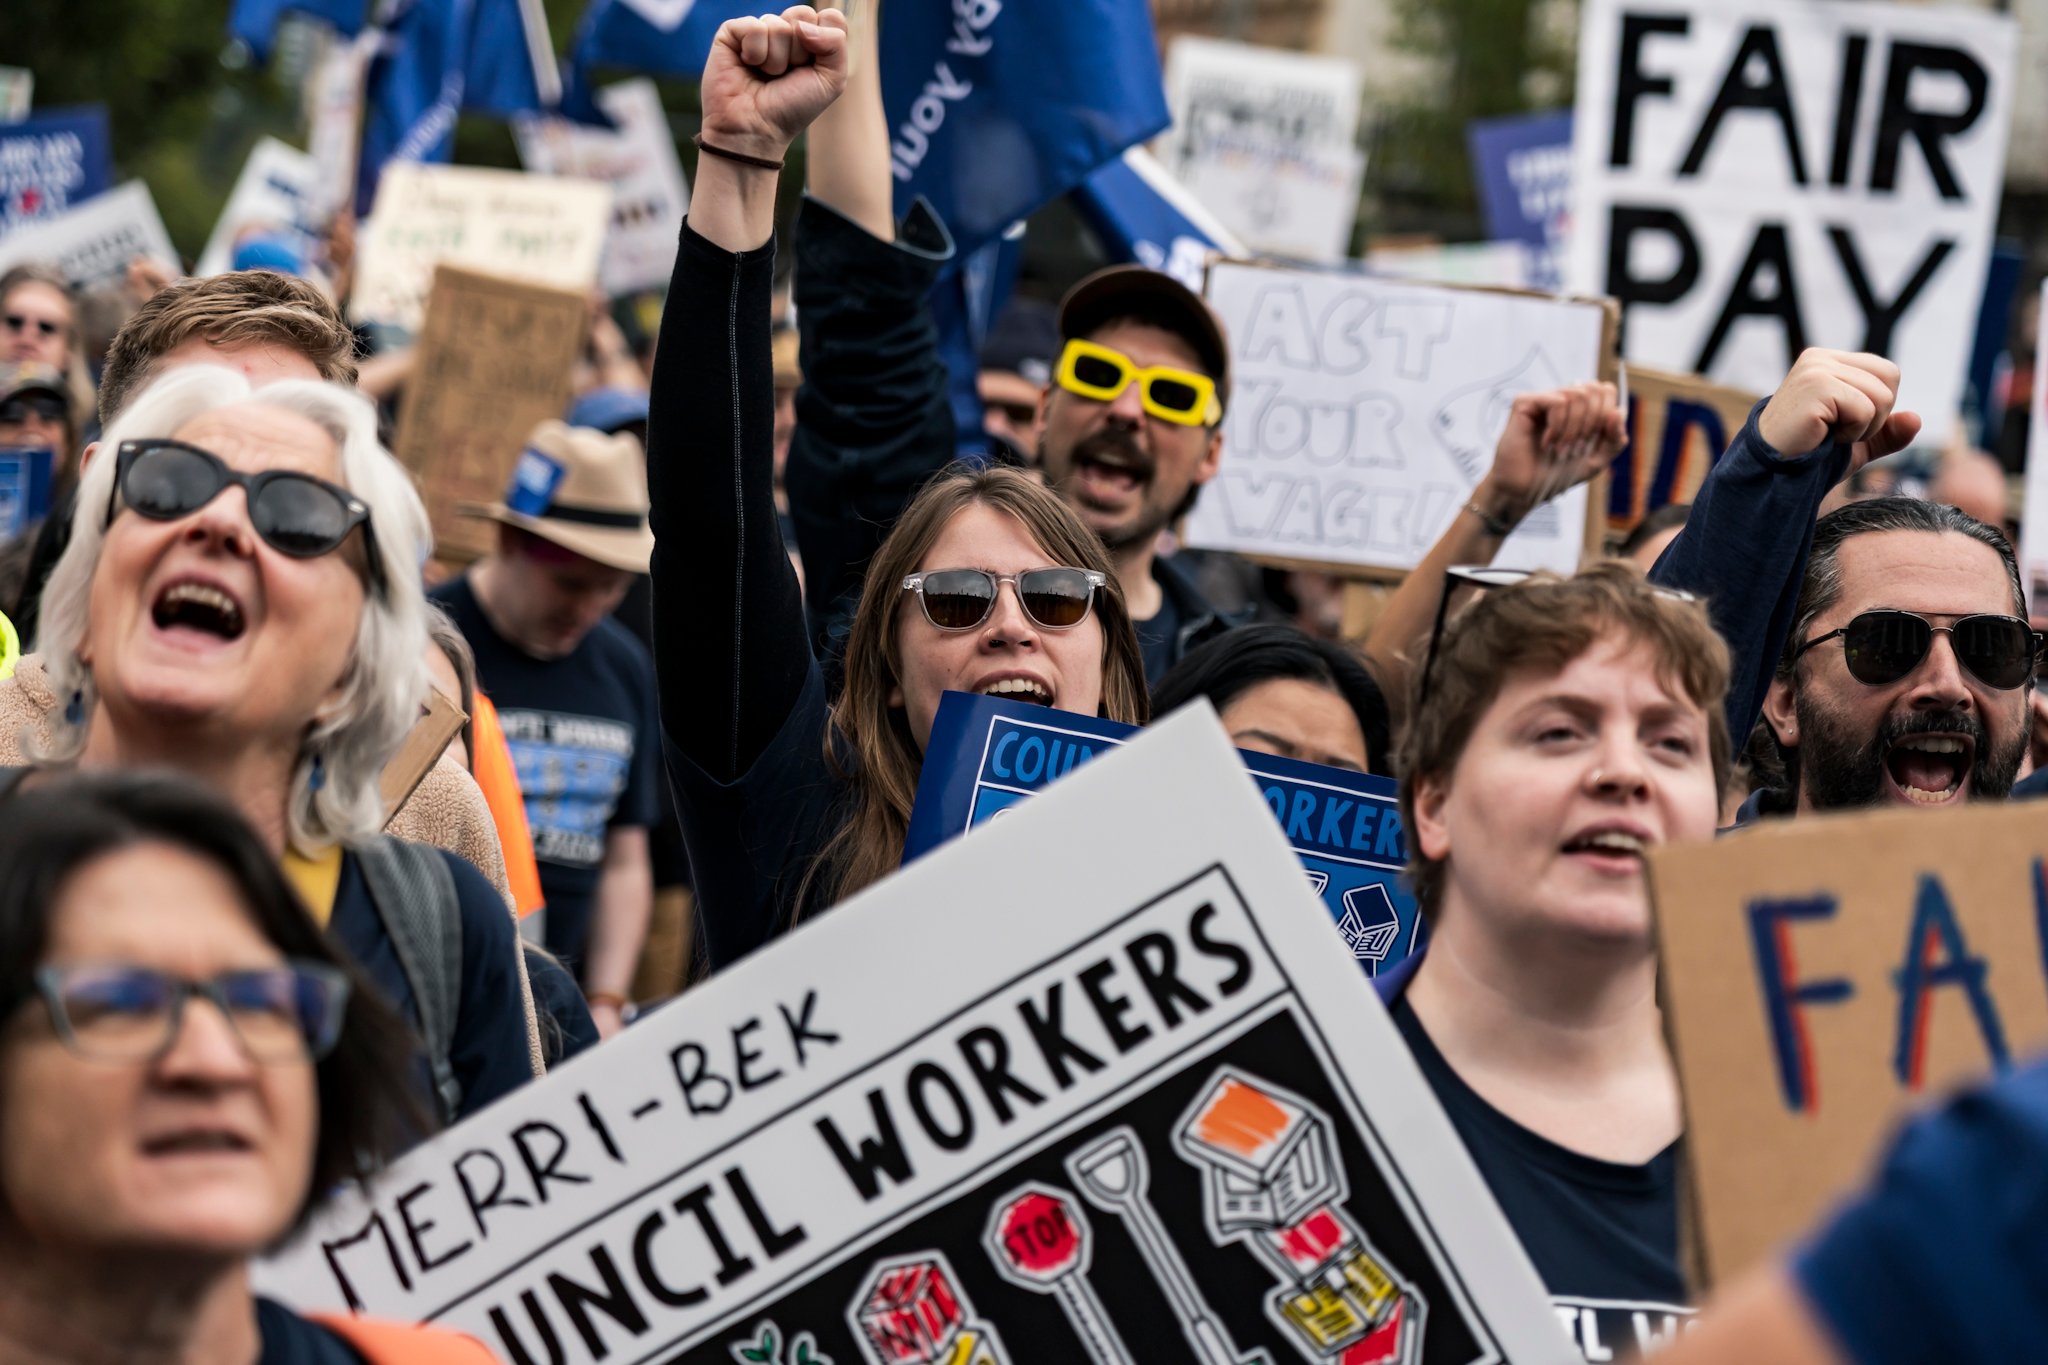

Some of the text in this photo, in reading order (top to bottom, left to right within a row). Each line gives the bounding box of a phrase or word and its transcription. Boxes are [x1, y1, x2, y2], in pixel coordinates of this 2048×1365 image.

[1609, 12, 1988, 201] FAIR
[1239, 284, 1456, 381] ACT
[1607, 204, 1958, 374] PAY
[1231, 375, 1407, 470] YOUR
[992, 731, 1411, 860] COU ORKER
[814, 902, 1254, 1202] WORKERS
[320, 988, 841, 1316] MERRI-BEK
[1003, 1203, 1070, 1266] STOP
